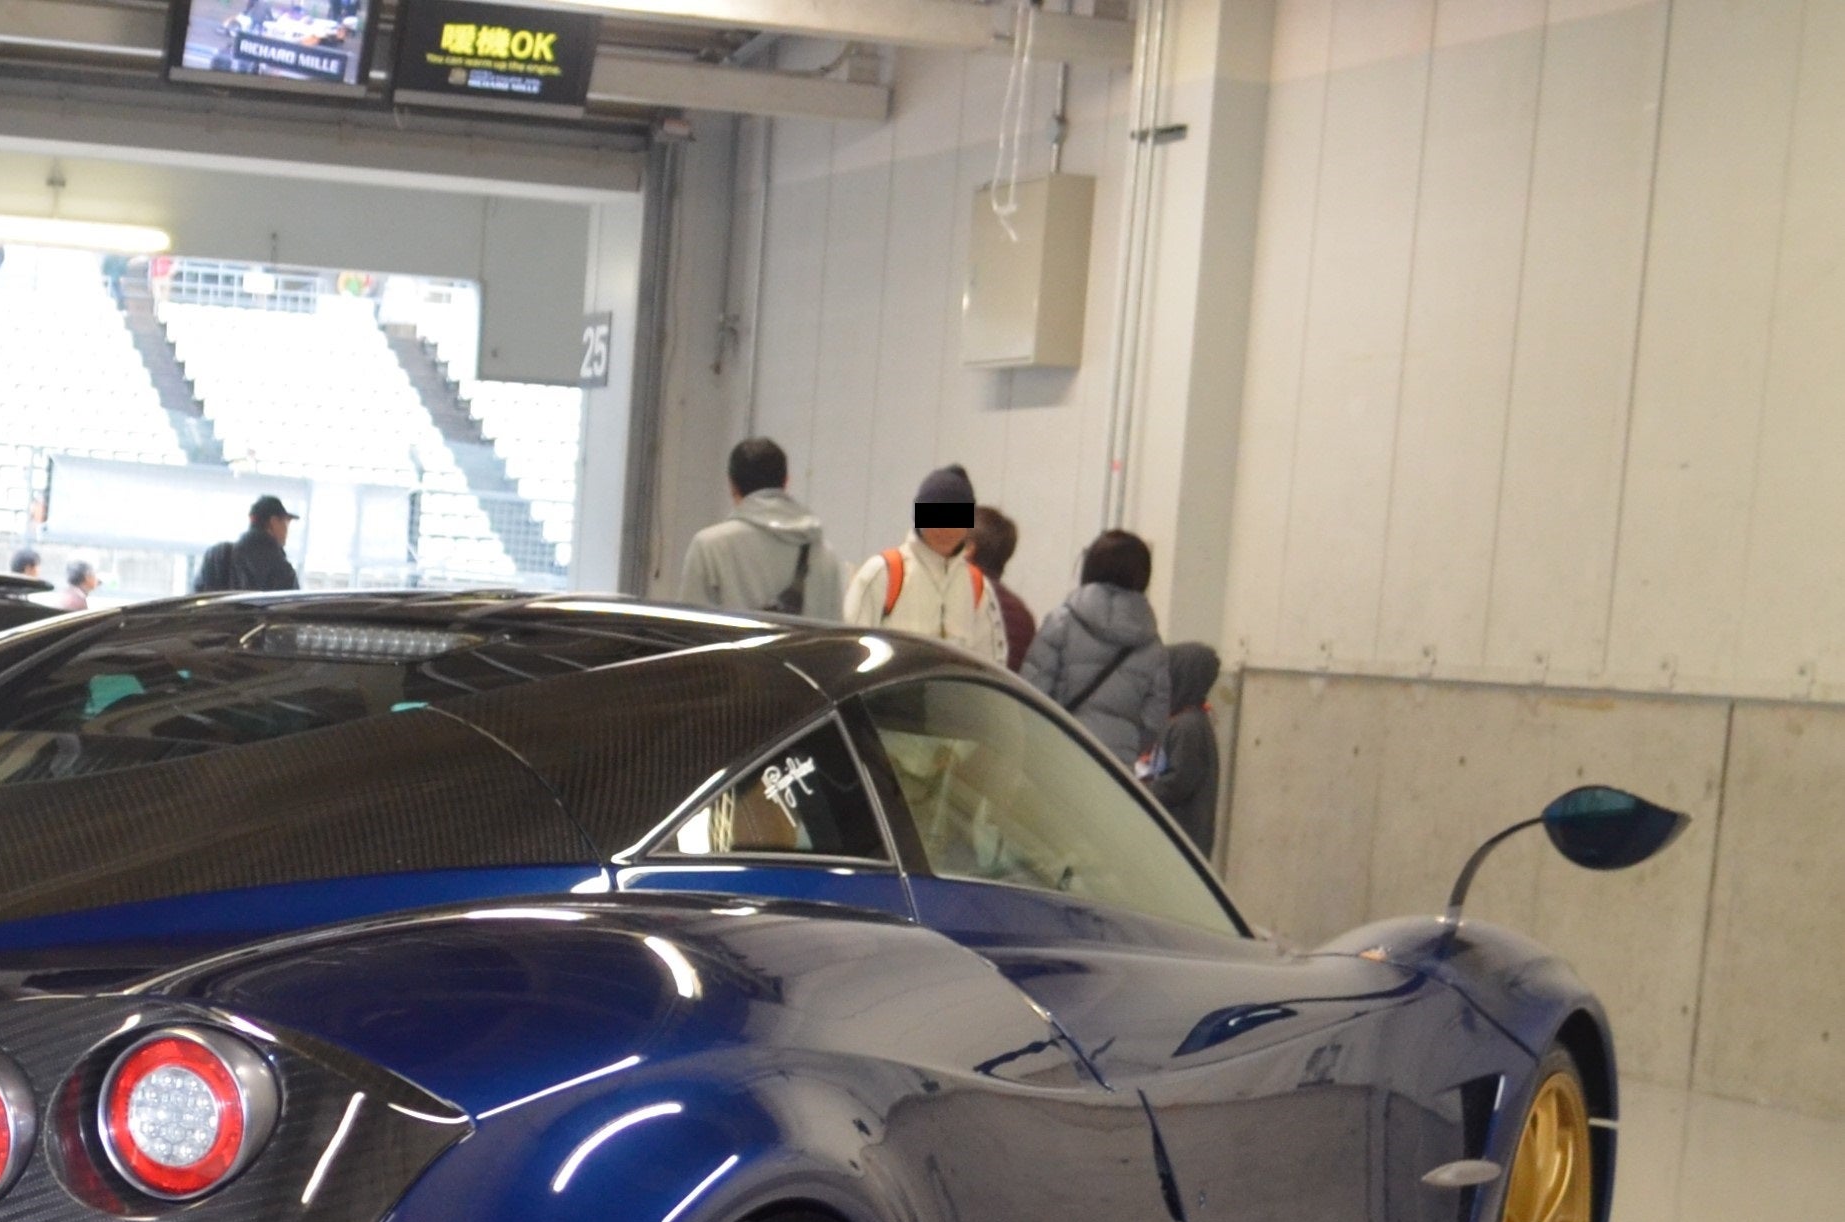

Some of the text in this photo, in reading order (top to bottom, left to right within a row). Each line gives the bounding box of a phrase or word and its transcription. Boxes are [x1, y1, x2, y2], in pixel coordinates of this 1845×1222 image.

[239, 39, 341, 74] RICHARD MILLE
[440, 23, 557, 62] 暖機OK
[579, 324, 609, 378] 25
